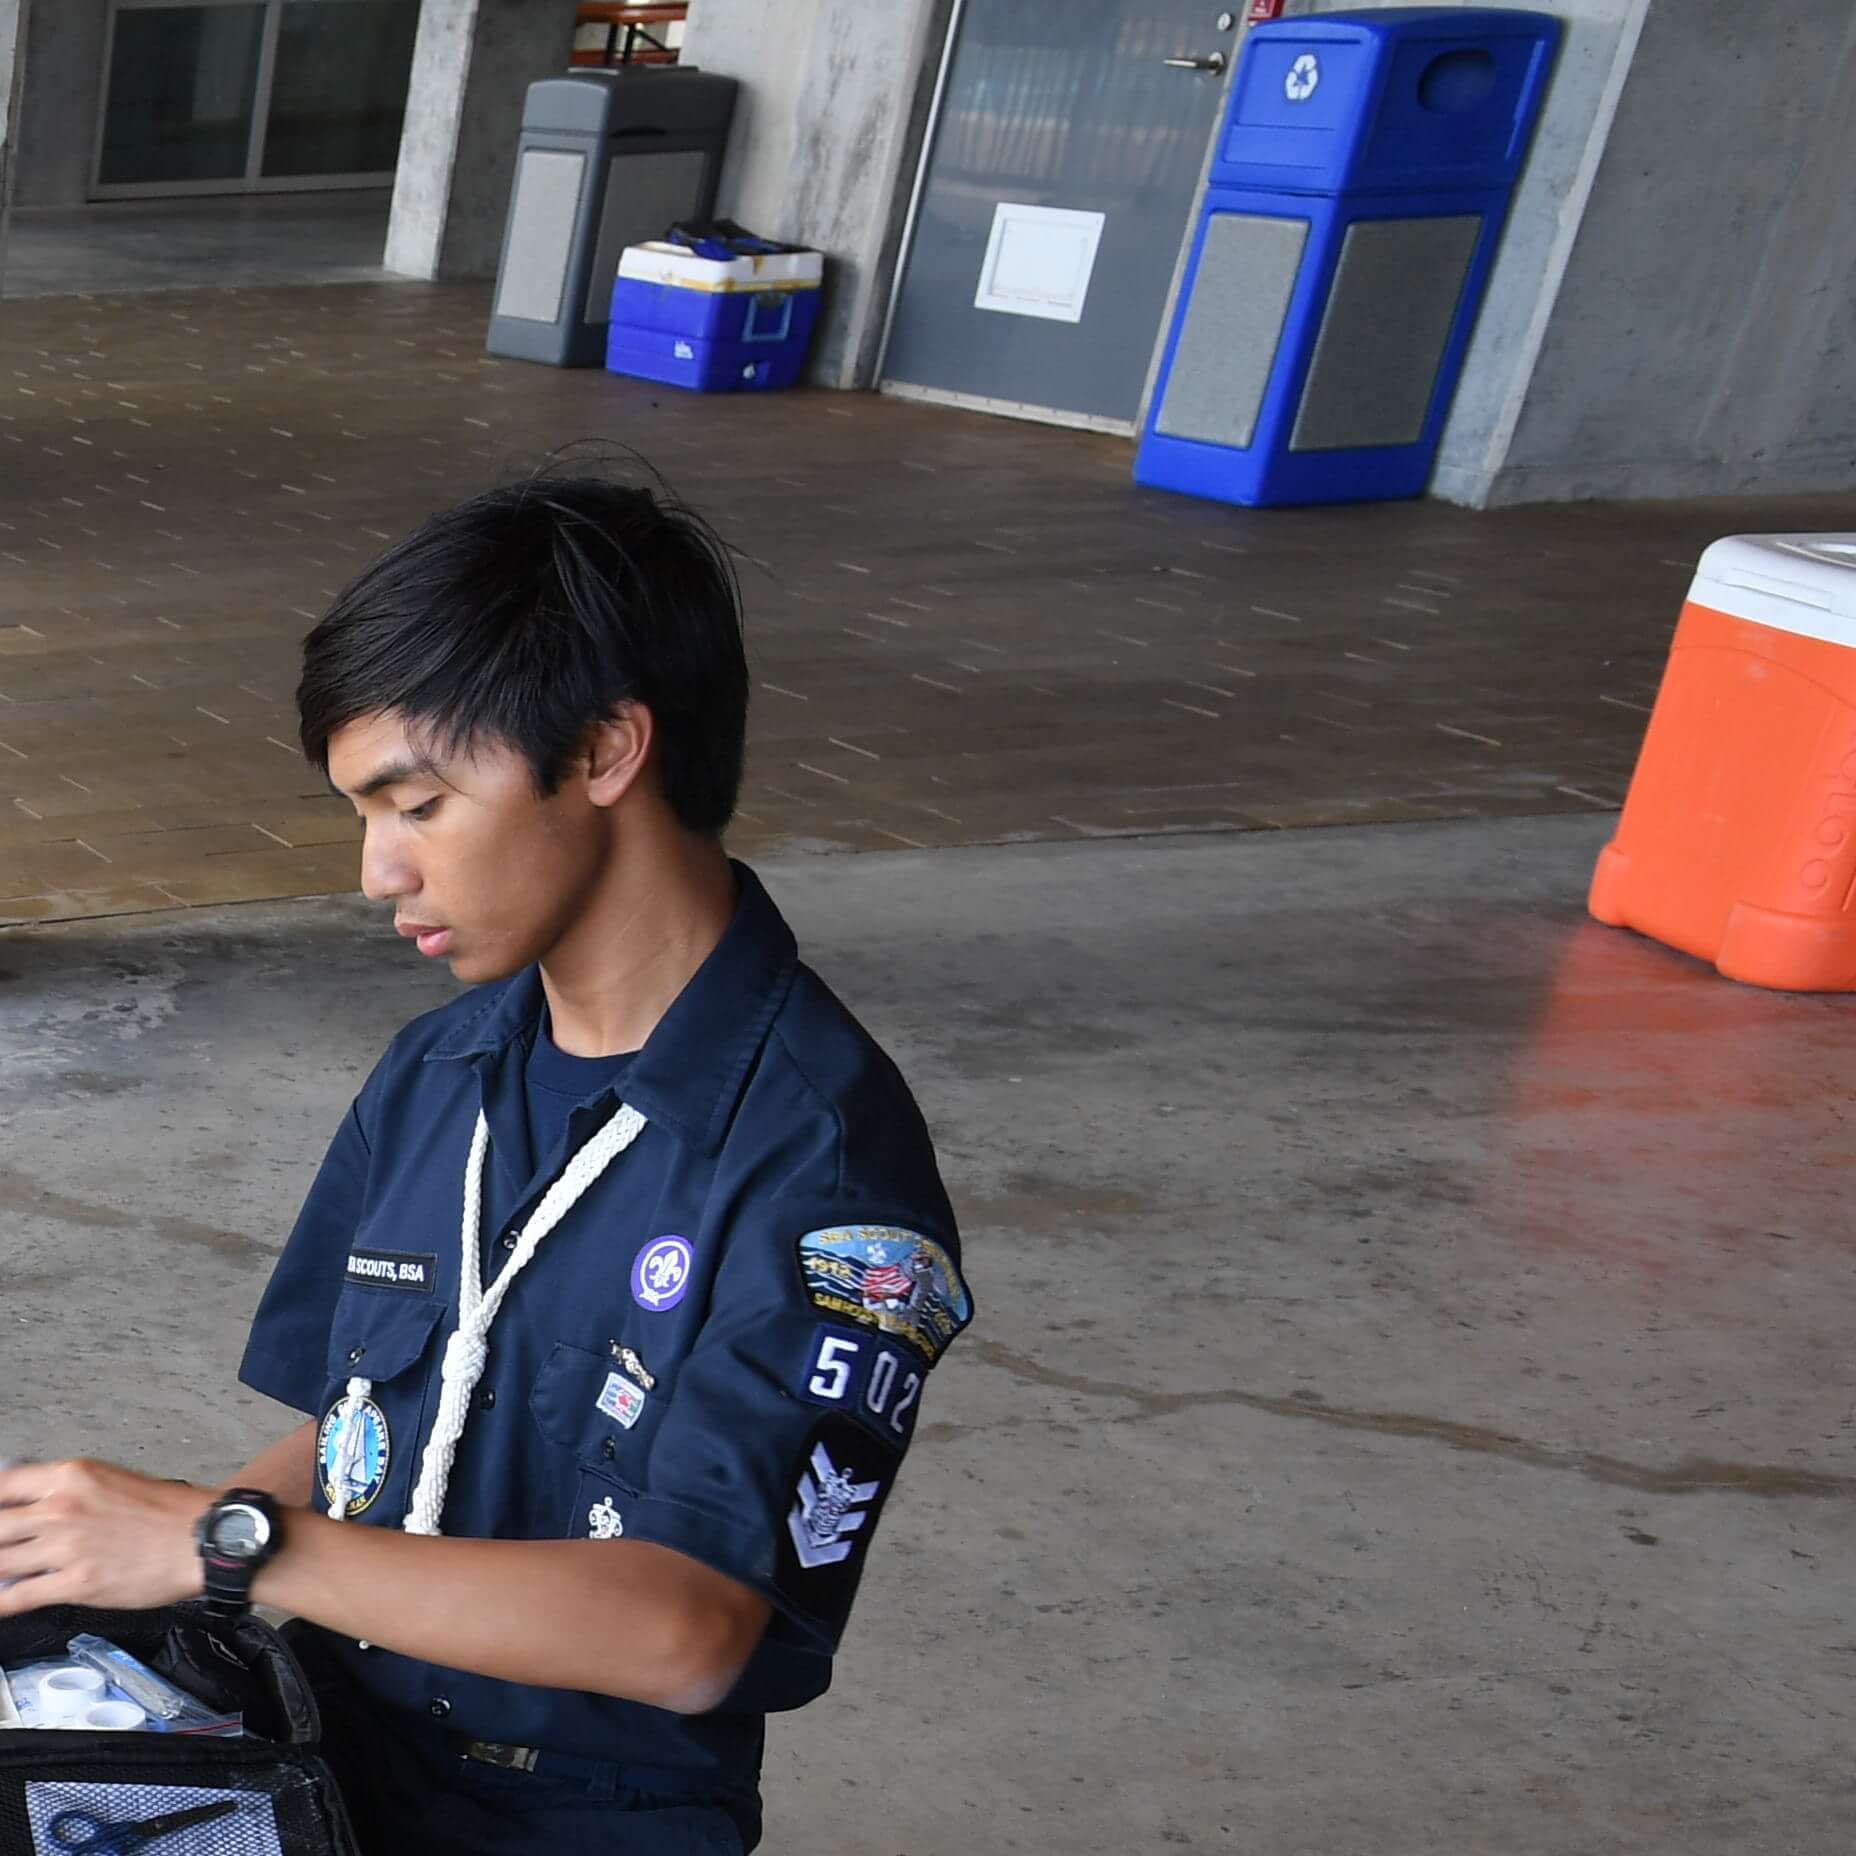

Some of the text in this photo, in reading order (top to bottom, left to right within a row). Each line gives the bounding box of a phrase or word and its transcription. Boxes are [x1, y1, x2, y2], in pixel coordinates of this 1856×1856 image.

[355, 1257, 398, 1282] SCOUTS,
[399, 1264, 425, 1282] BSA
[808, 1336, 919, 1434] 502
